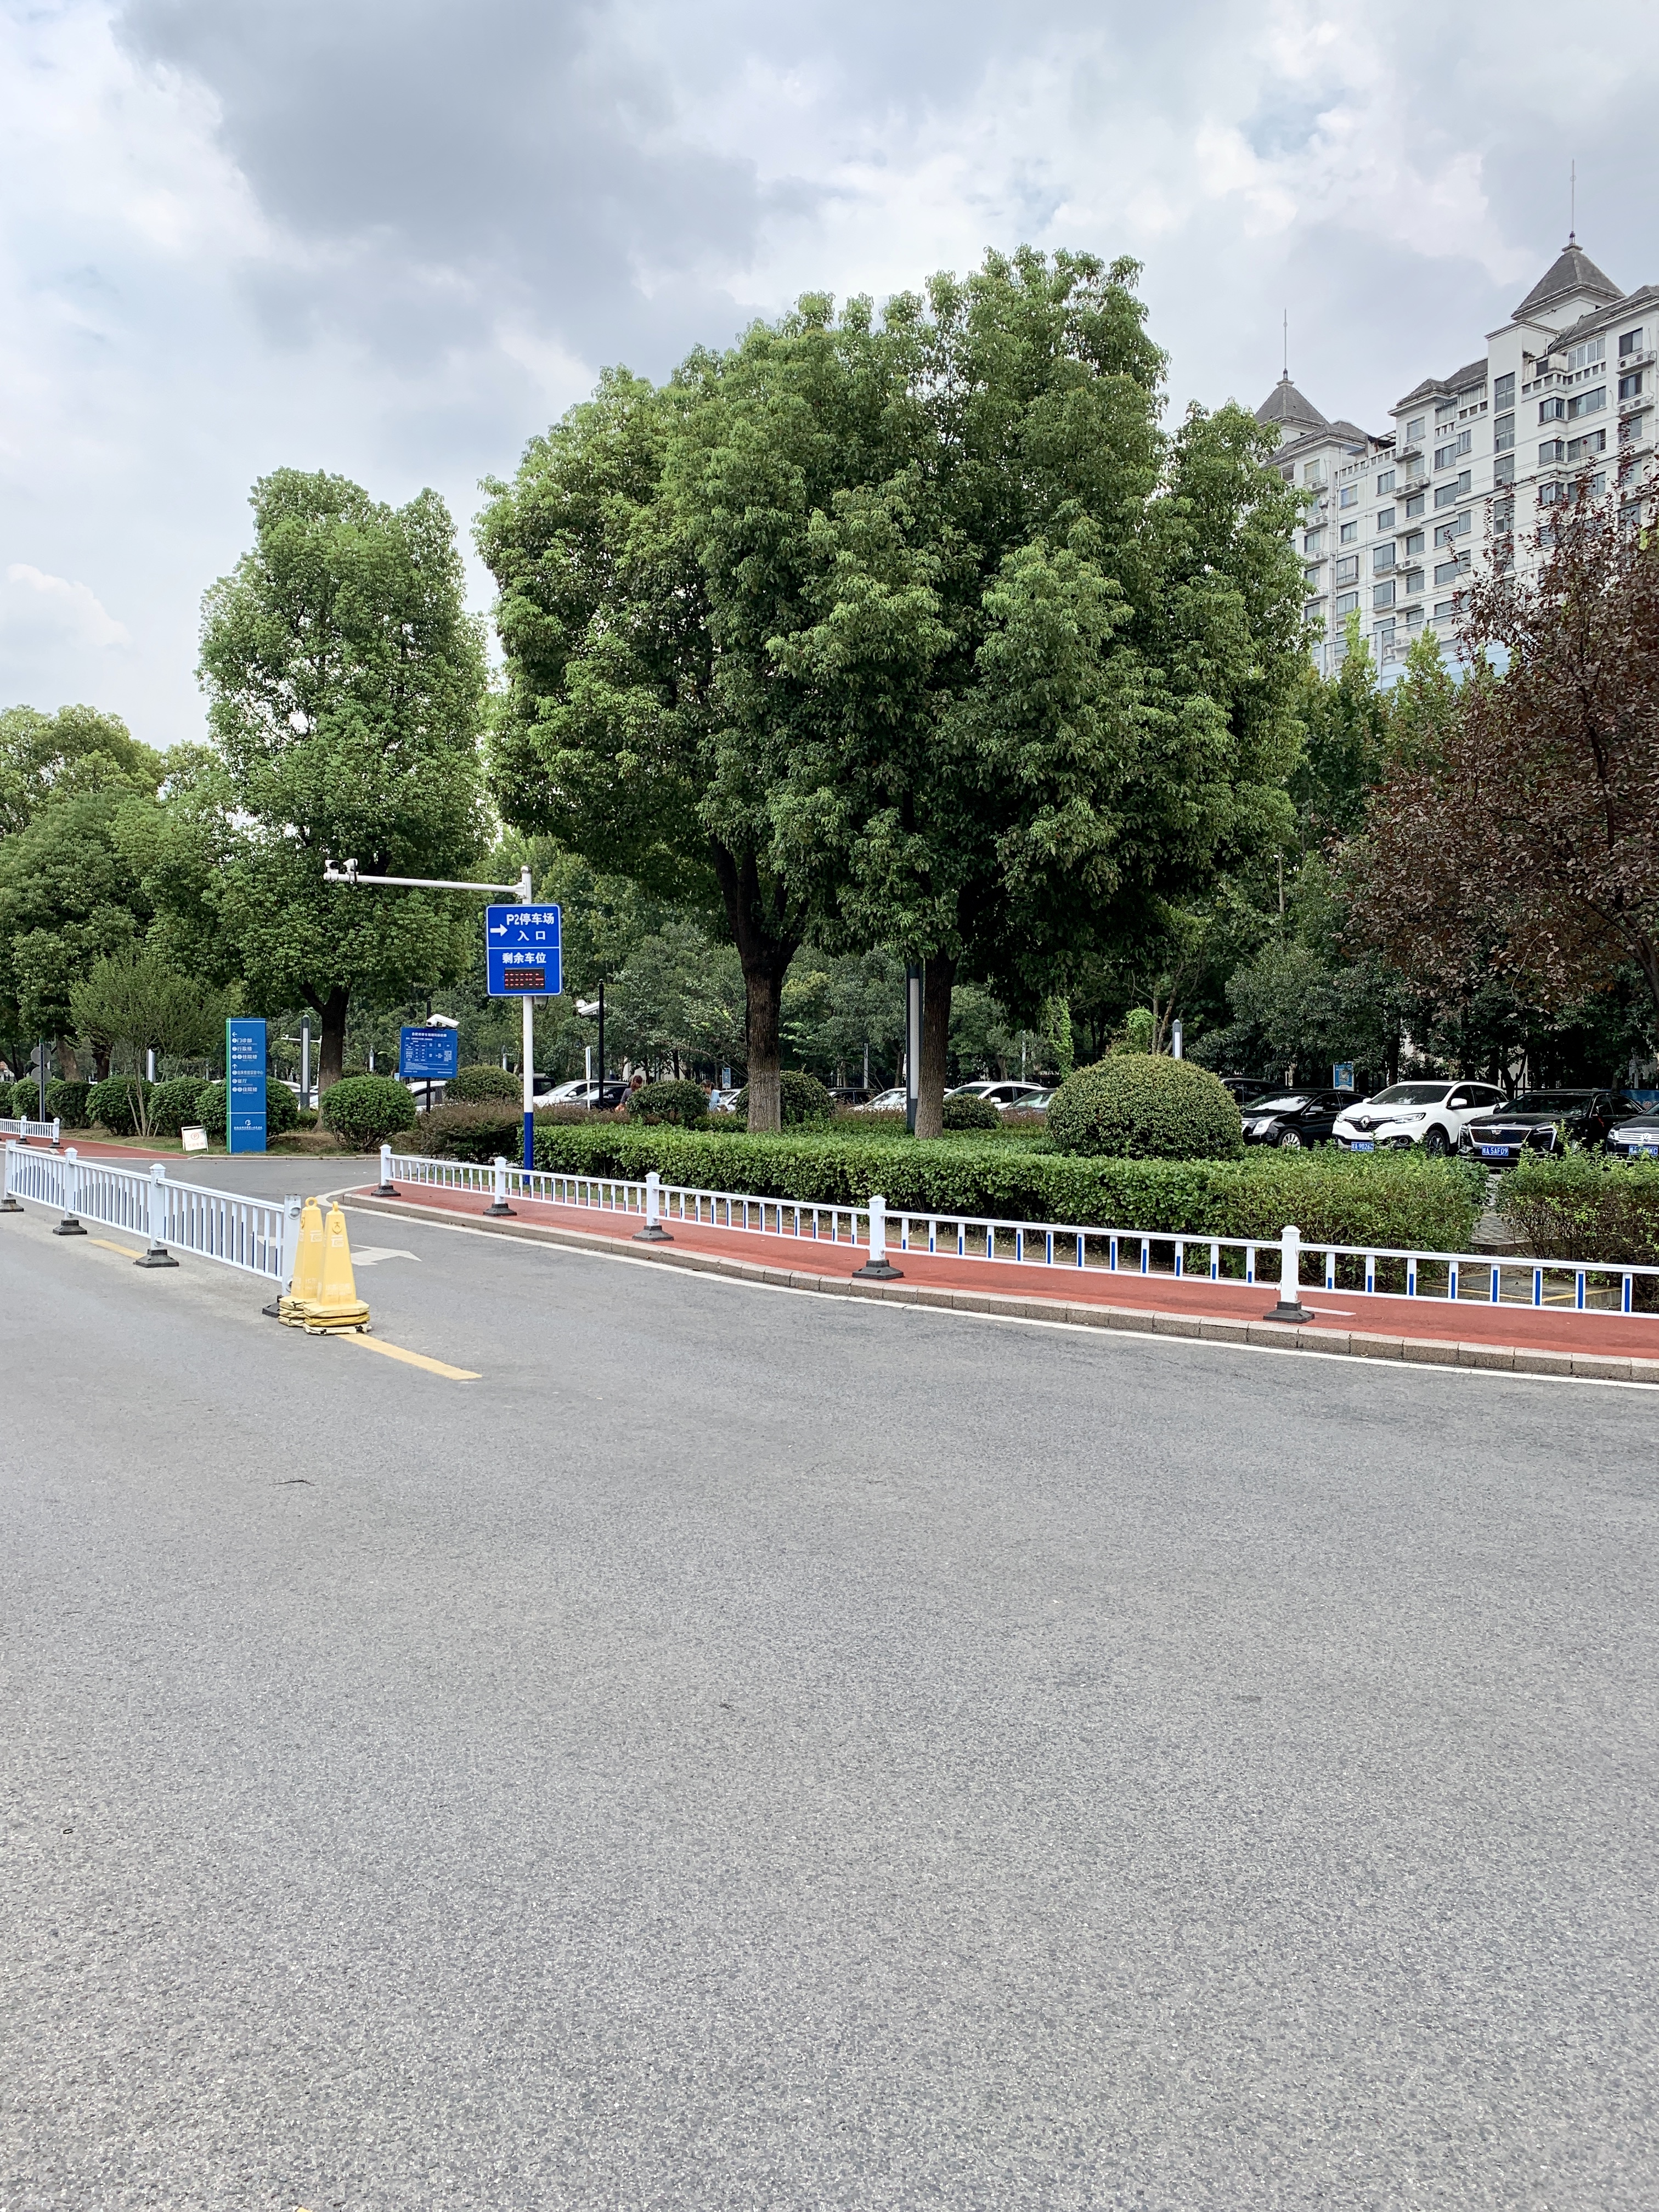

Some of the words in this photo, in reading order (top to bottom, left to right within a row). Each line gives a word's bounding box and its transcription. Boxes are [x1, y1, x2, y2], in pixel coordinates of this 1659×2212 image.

[506, 913, 555, 926] P2停车场
[502, 952, 547, 964] 剩余车位
